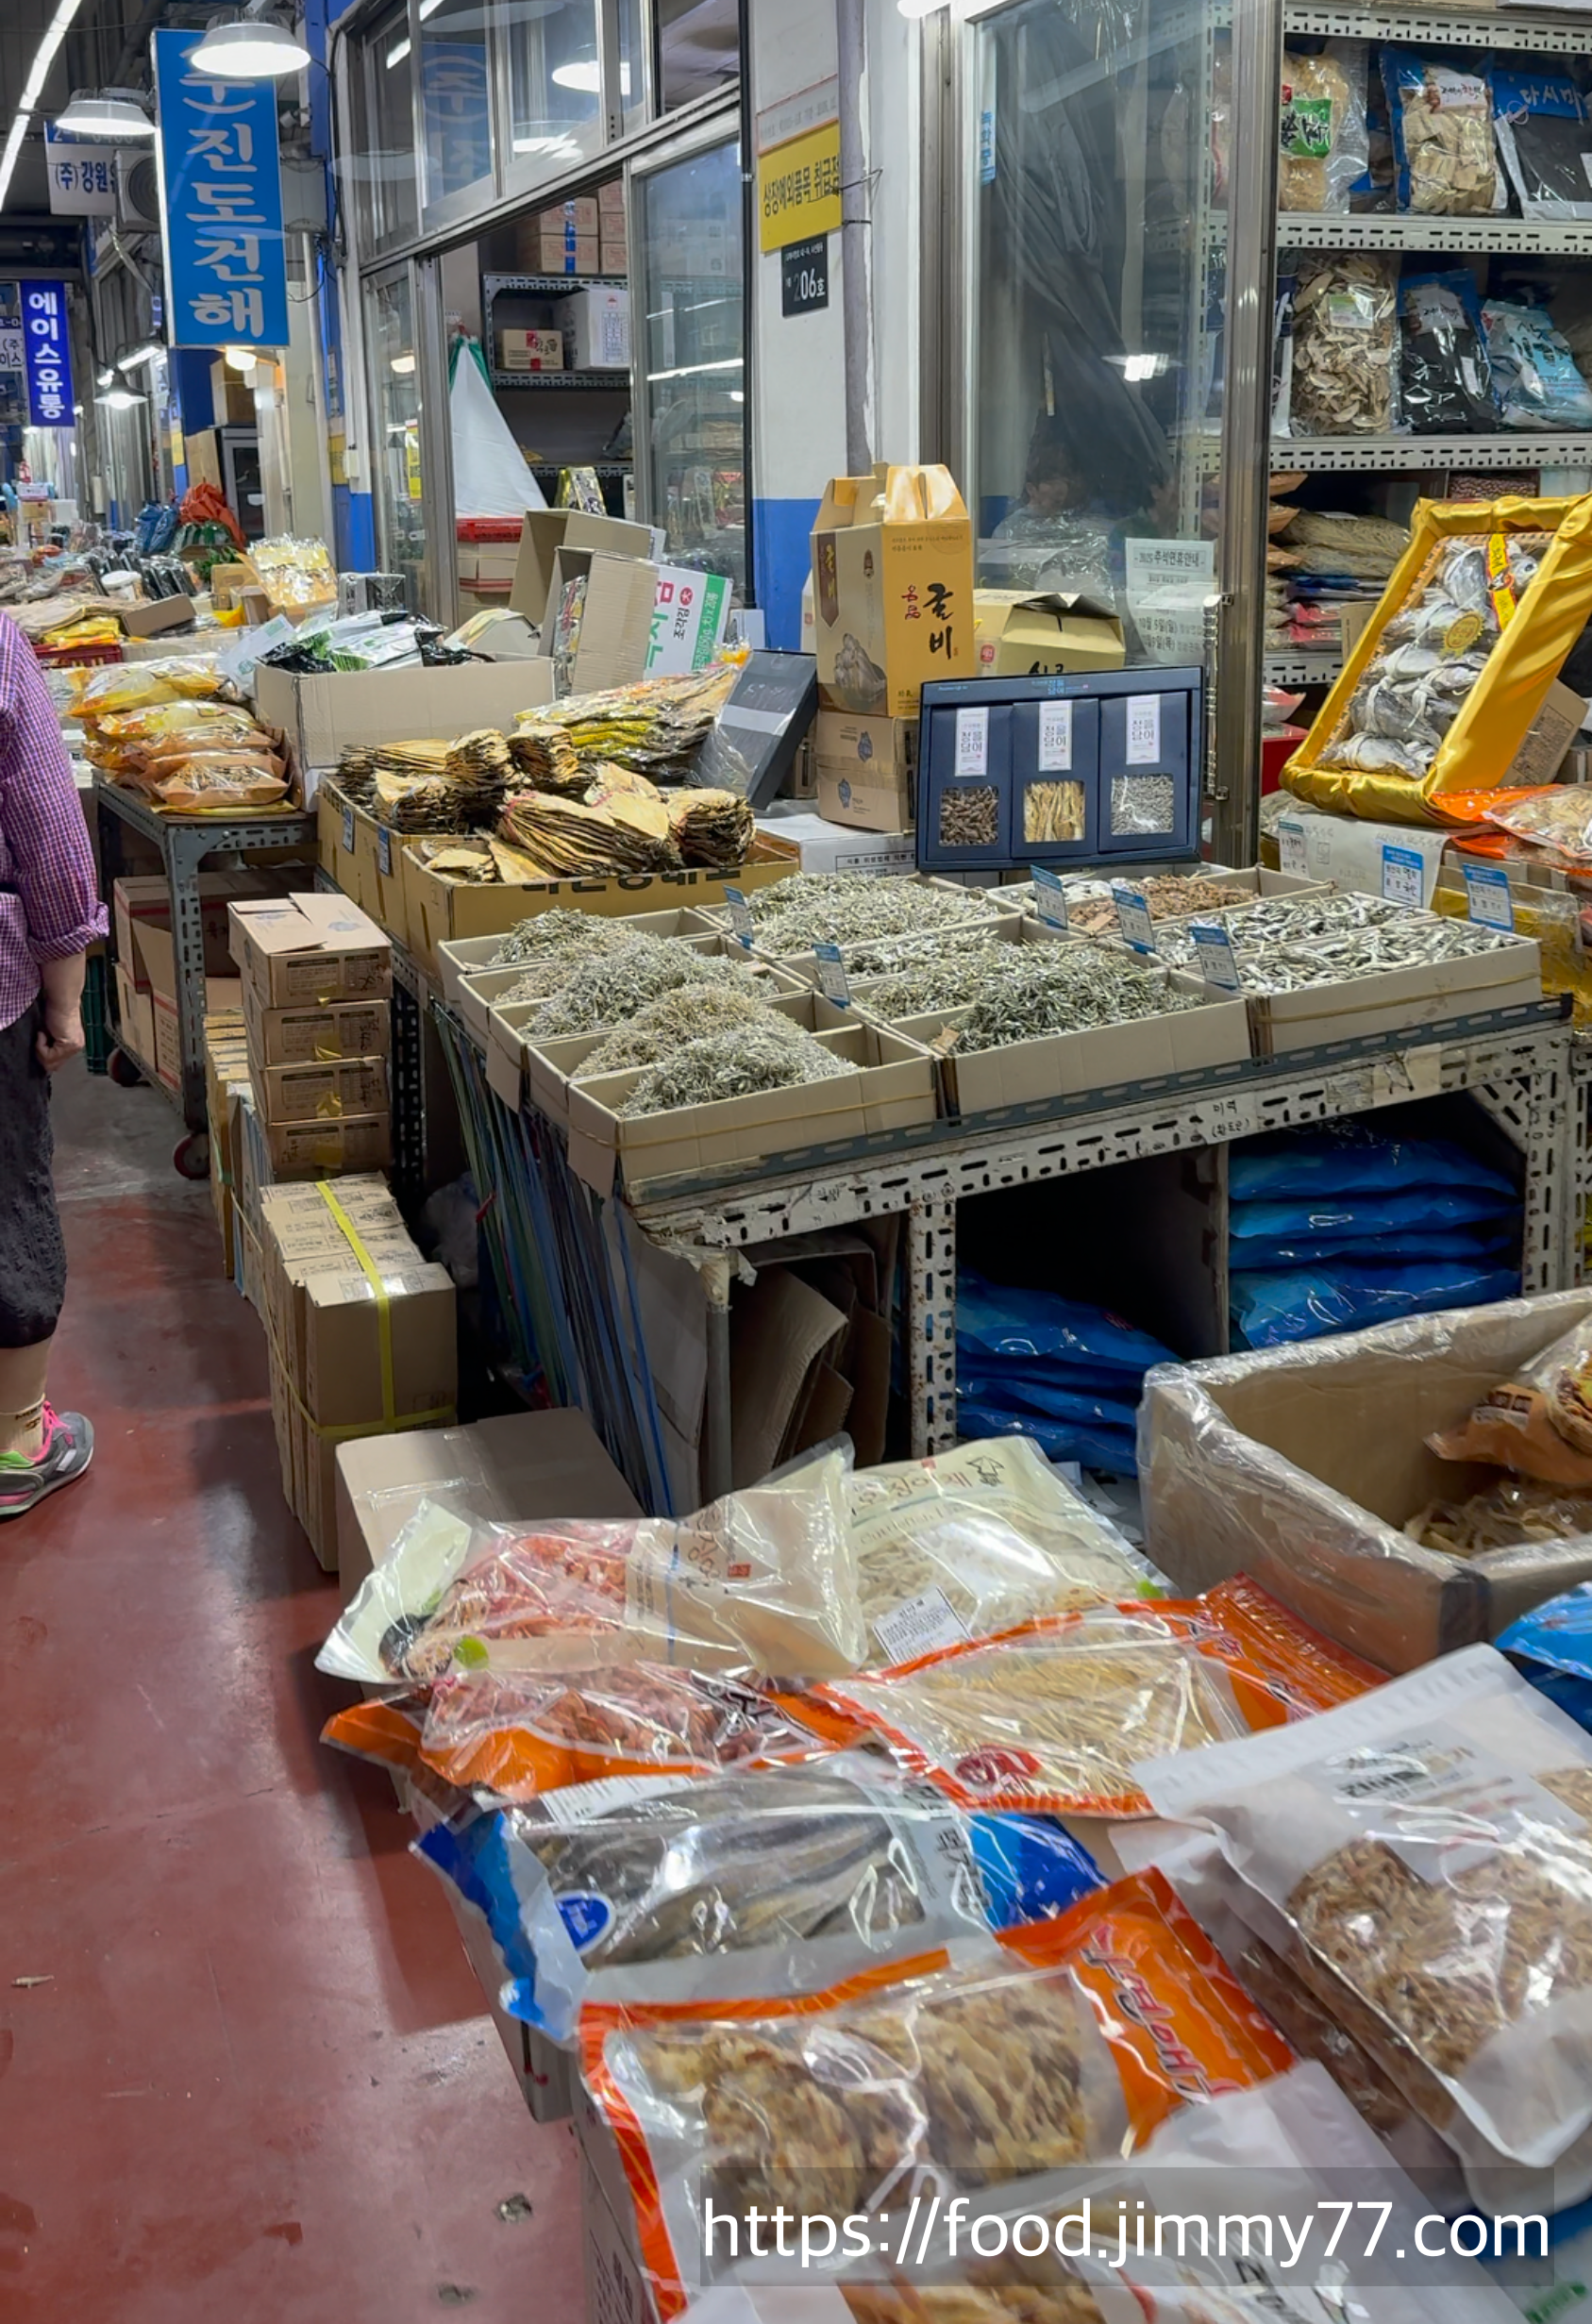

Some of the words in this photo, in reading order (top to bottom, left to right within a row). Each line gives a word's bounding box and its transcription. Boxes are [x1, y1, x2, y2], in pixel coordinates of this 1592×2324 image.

[28, 292, 65, 419] 에이스유통
[673, 607, 690, 641] 조각김
[923, 583, 954, 660] 굴비
